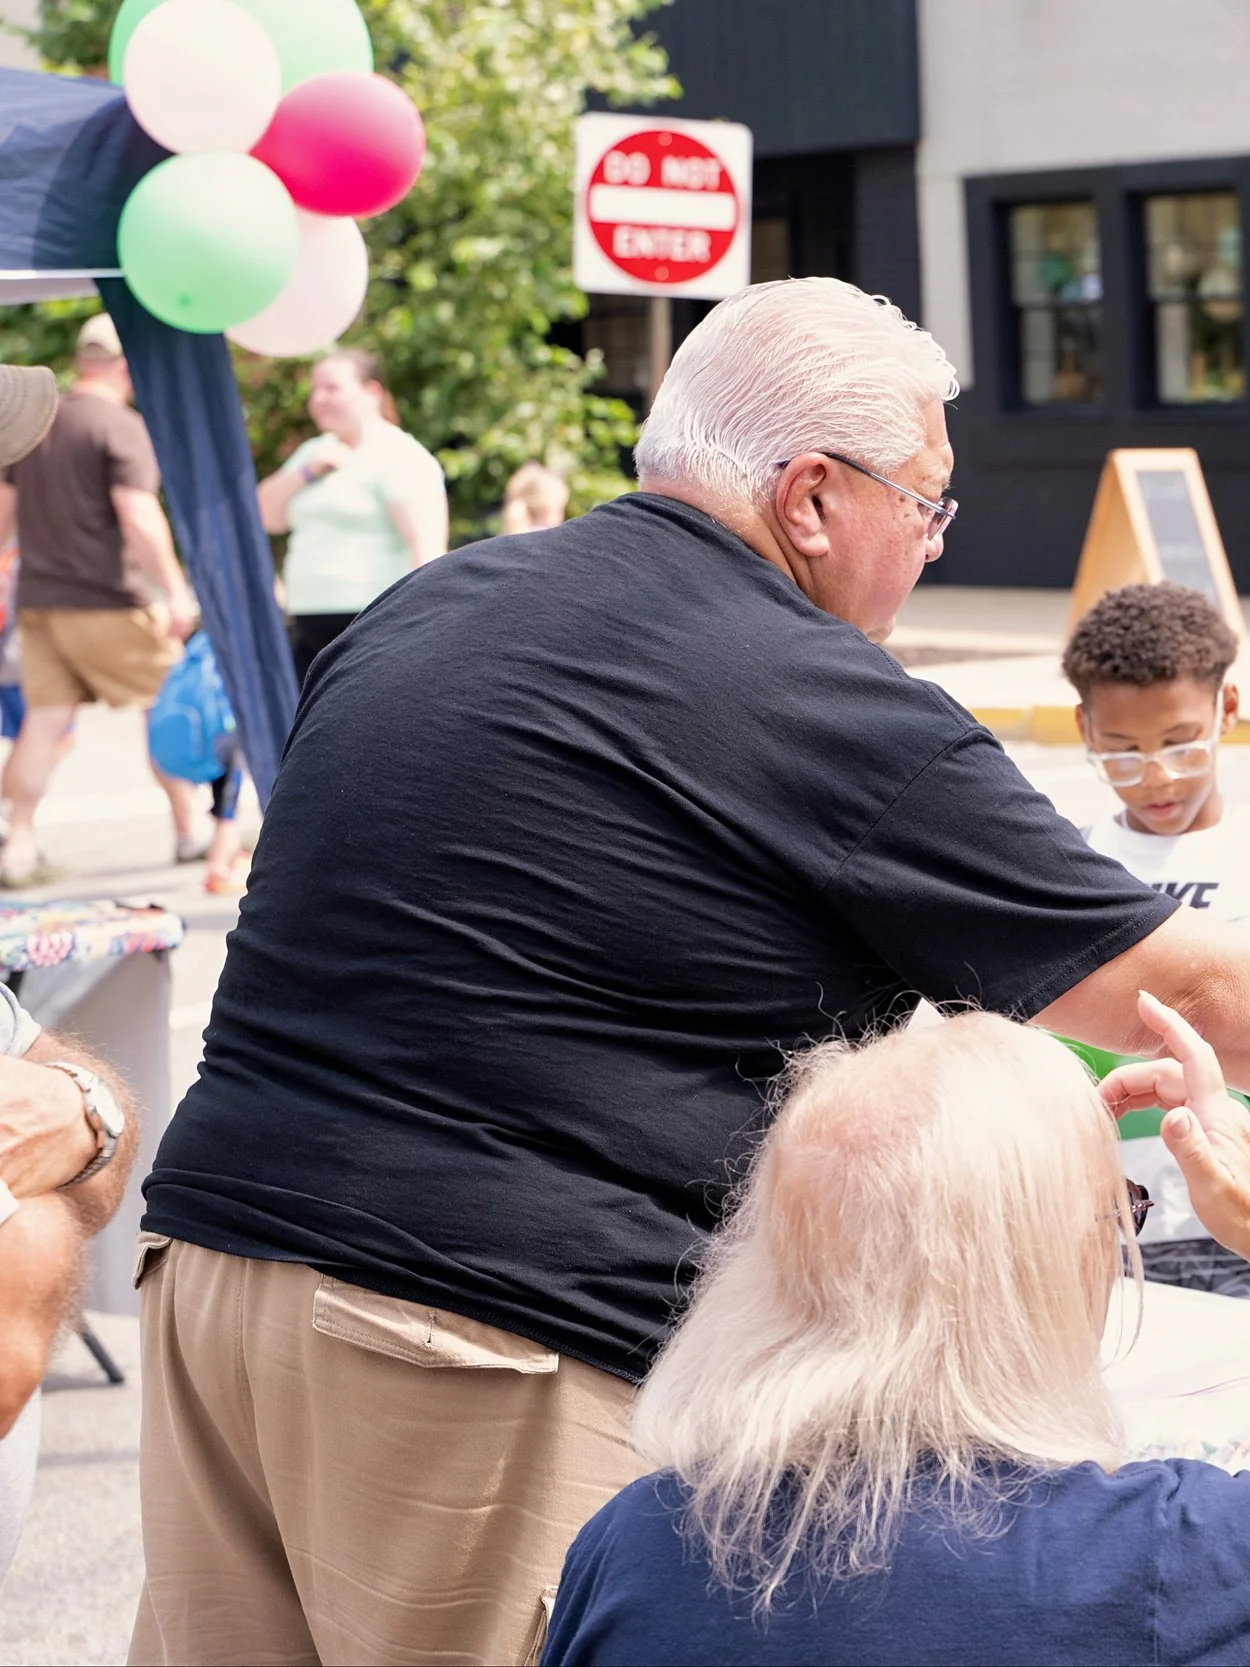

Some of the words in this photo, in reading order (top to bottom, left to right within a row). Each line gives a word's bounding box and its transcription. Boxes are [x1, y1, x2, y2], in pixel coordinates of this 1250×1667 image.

[603, 150, 651, 185] DO
[660, 154, 722, 190] NOT
[613, 224, 712, 263] ENTER
